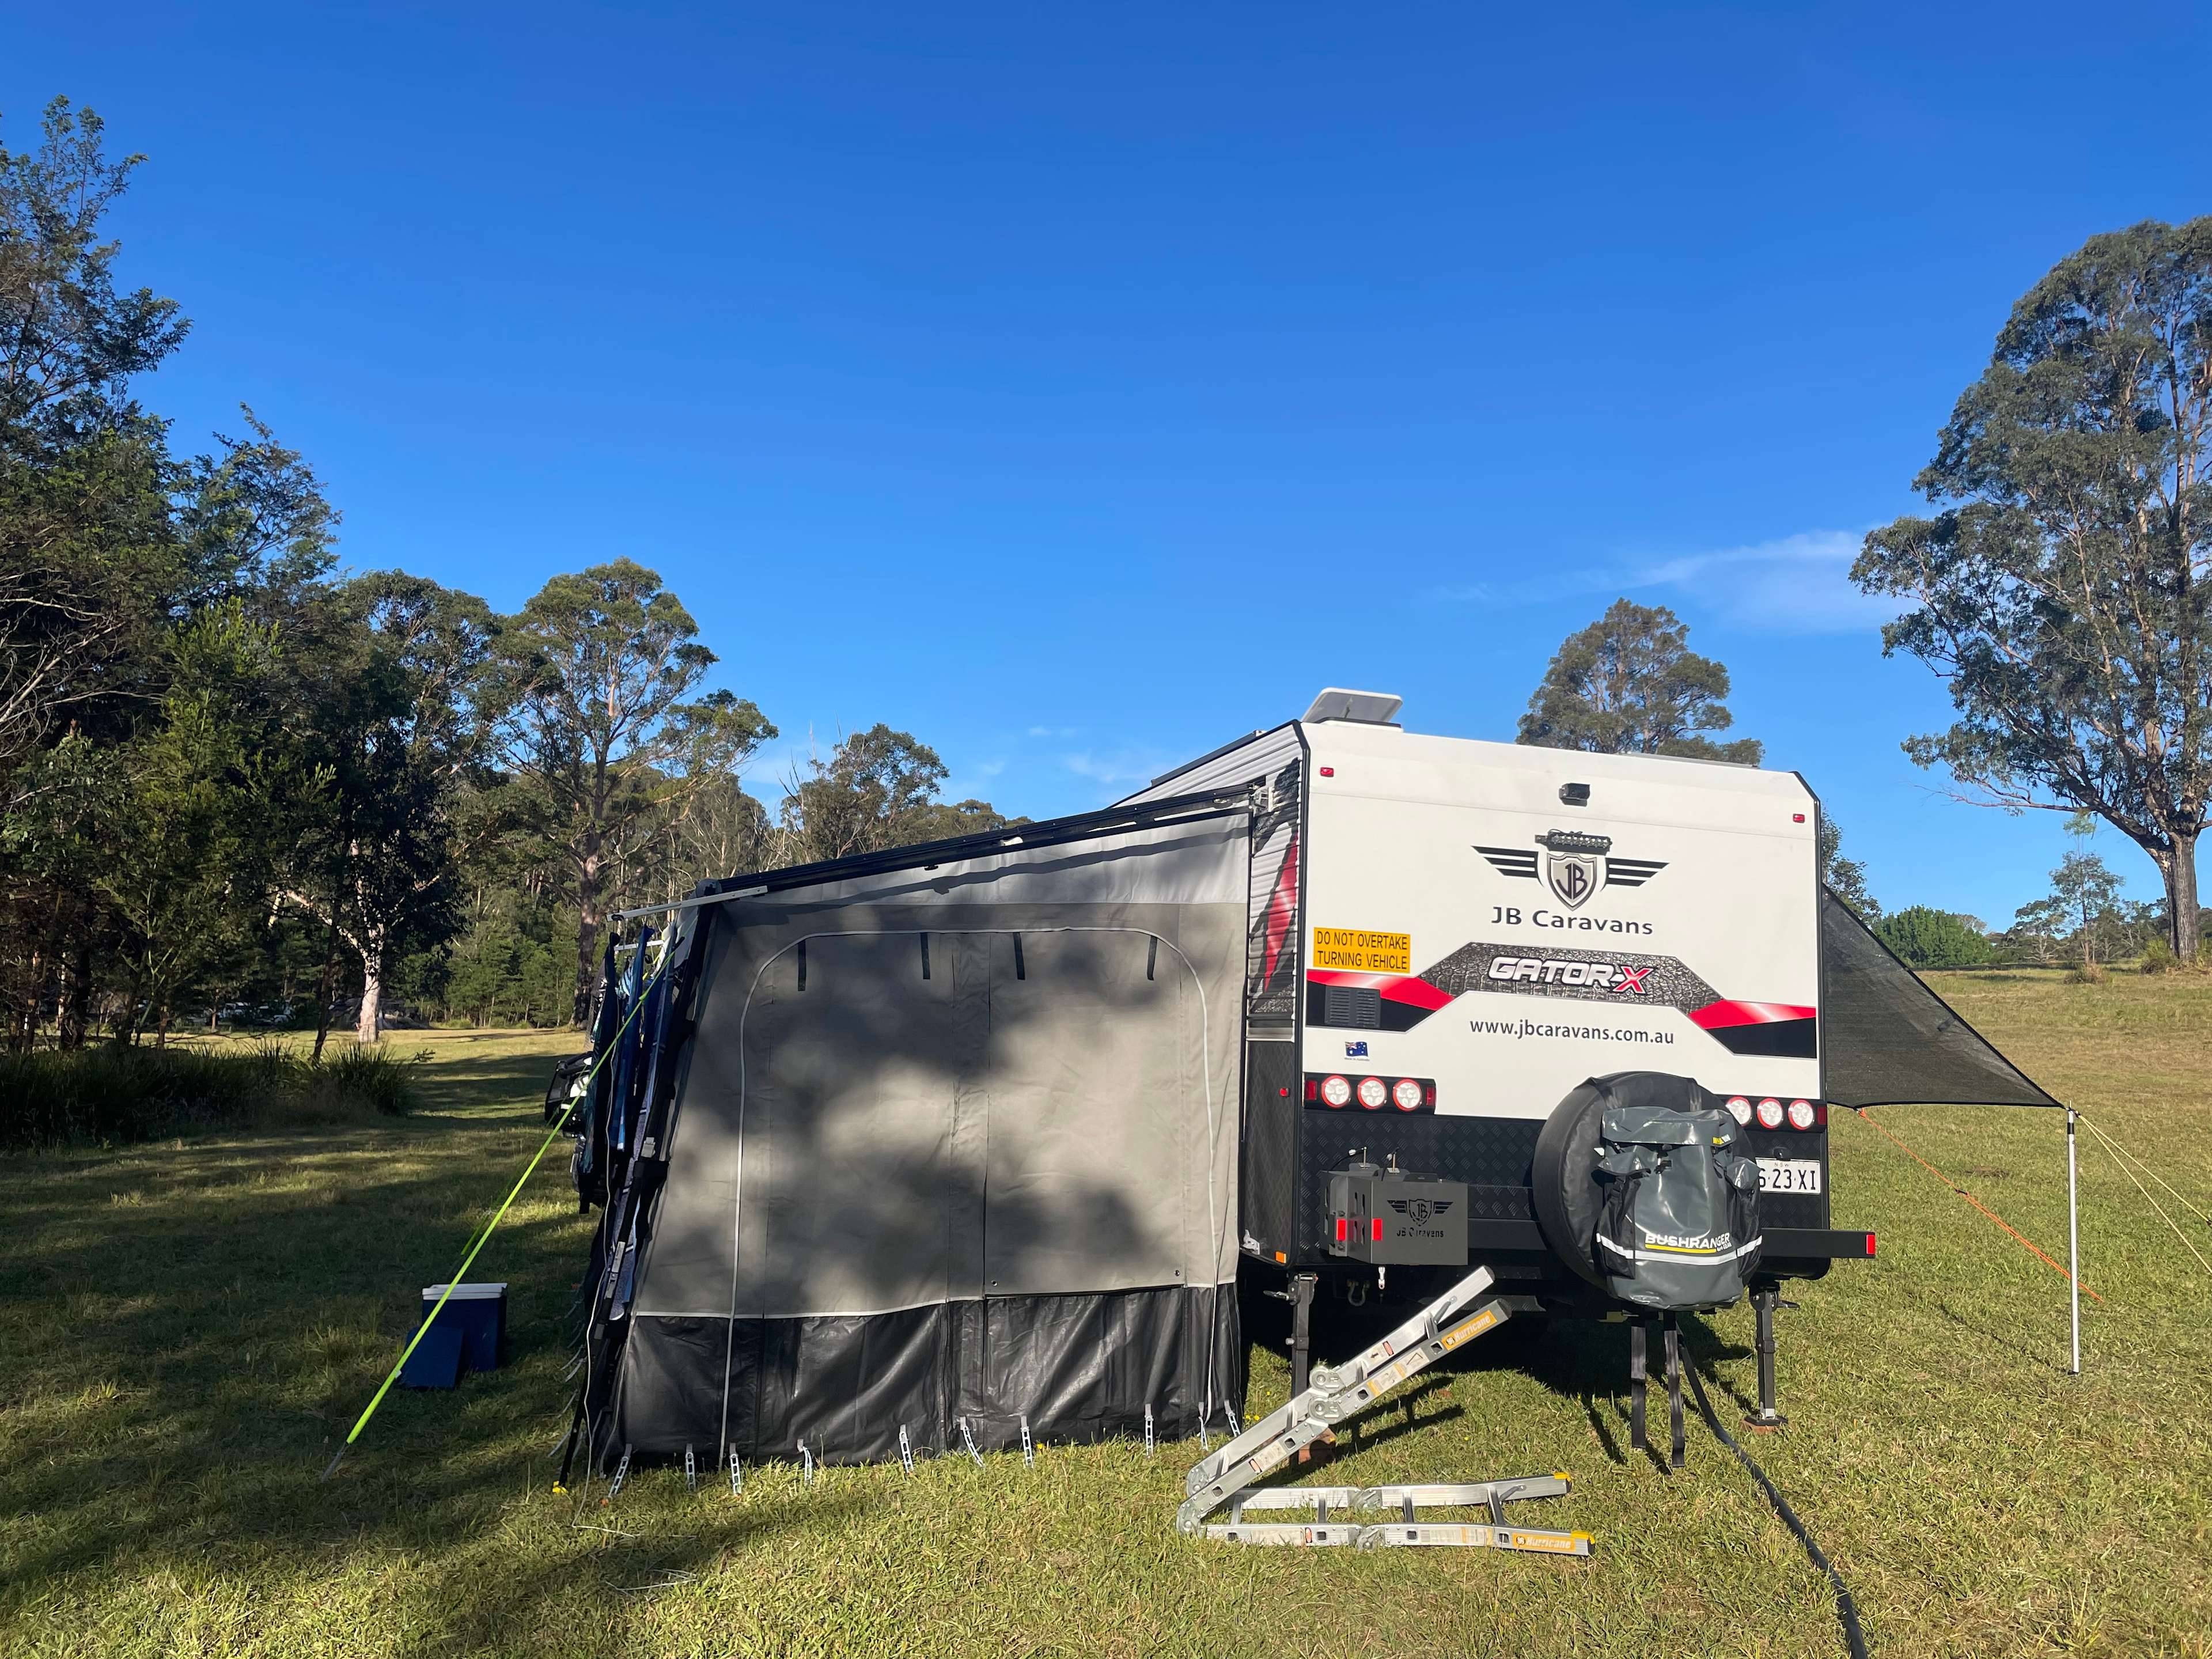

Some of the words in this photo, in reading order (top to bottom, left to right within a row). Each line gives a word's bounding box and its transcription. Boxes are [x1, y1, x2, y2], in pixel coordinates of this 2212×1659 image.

[1556, 862, 1588, 900] JB
[1491, 906, 1522, 925] JB
[1532, 910, 1653, 934] Caravans
[1317, 931, 1331, 945] DO
[1334, 932, 1354, 946] NOT
[1358, 934, 1407, 950] OVERTAKE
[1318, 950, 1362, 967] TURNING
[1367, 953, 1407, 969] VEHICLE
[1488, 956, 1654, 994] GATOR-X
[1469, 1019, 1674, 1044] www.jbcaravans.com.au
[1645, 1232, 1730, 1249] BUSHRANGER
[1453, 1315, 1491, 1342] Hurricane
[1526, 1536, 1571, 1549] Hurricane
